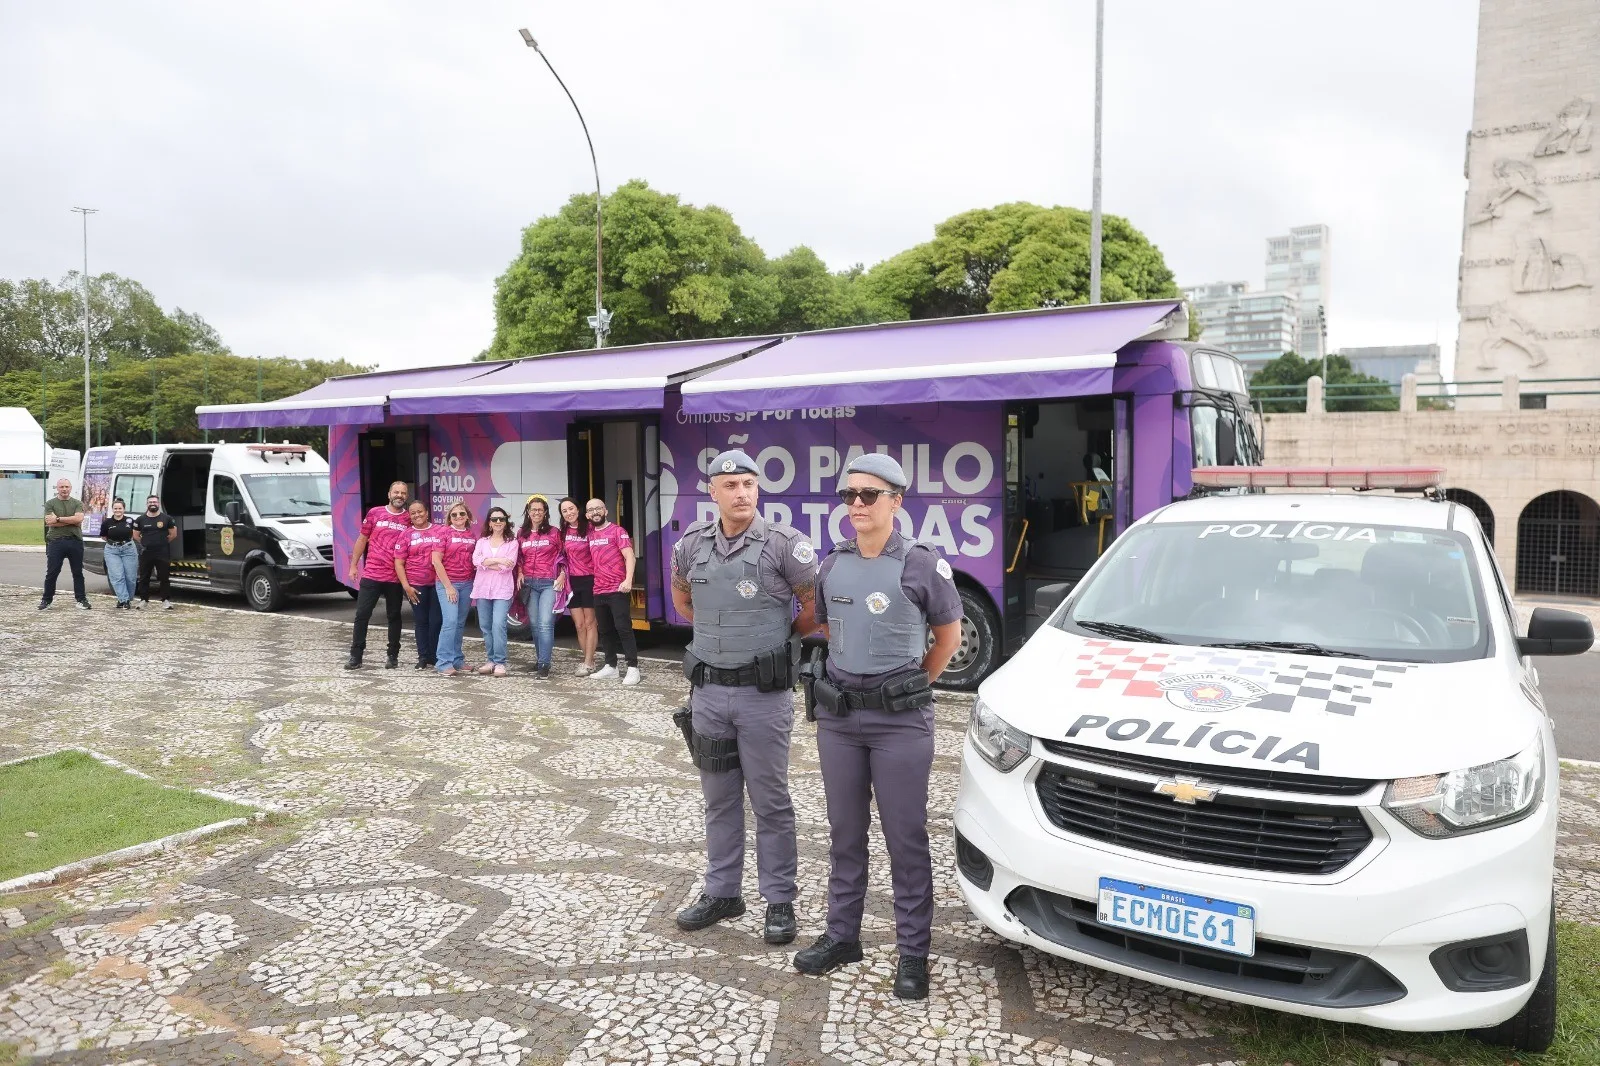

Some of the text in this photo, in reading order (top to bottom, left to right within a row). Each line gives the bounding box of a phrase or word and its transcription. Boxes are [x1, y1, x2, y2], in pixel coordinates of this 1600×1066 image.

[432, 452, 460, 473] SÃO
[696, 433, 796, 494] SO
[432, 474, 476, 492] PAULO
[432, 495, 464, 503] GOVERNO
[1198, 521, 1377, 544] POLÍCIA
[1220, 675, 1261, 693] MILITAR
[1065, 714, 1320, 771] POLÍCIA
[1161, 893, 1185, 904] BRASIL
[1099, 911, 1108, 922] BR
